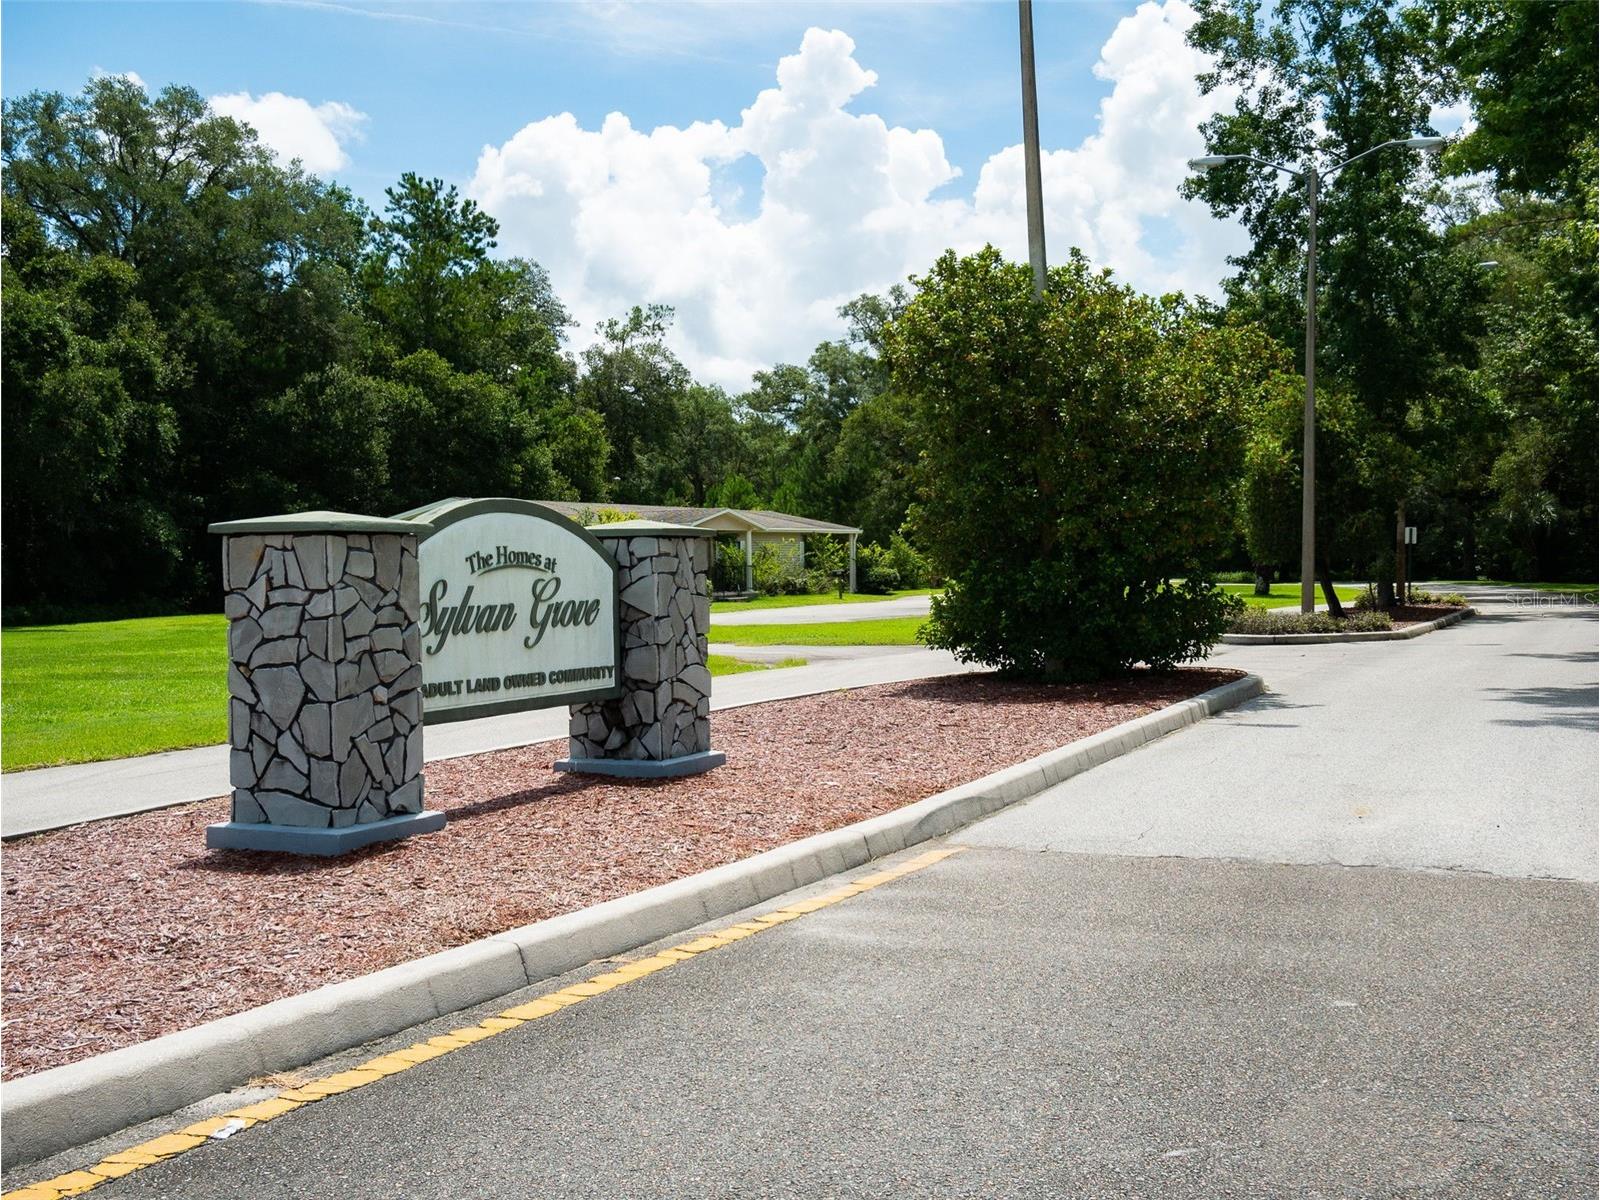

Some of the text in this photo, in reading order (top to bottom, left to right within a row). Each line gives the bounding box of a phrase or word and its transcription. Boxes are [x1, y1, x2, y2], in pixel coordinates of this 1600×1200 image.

[465, 545, 557, 575] The Homes at
[420, 577, 600, 656] Sylvan Grove
[466, 677, 501, 694] LAND
[503, 671, 547, 690] OWNED
[549, 665, 614, 685] COMMUNITY
